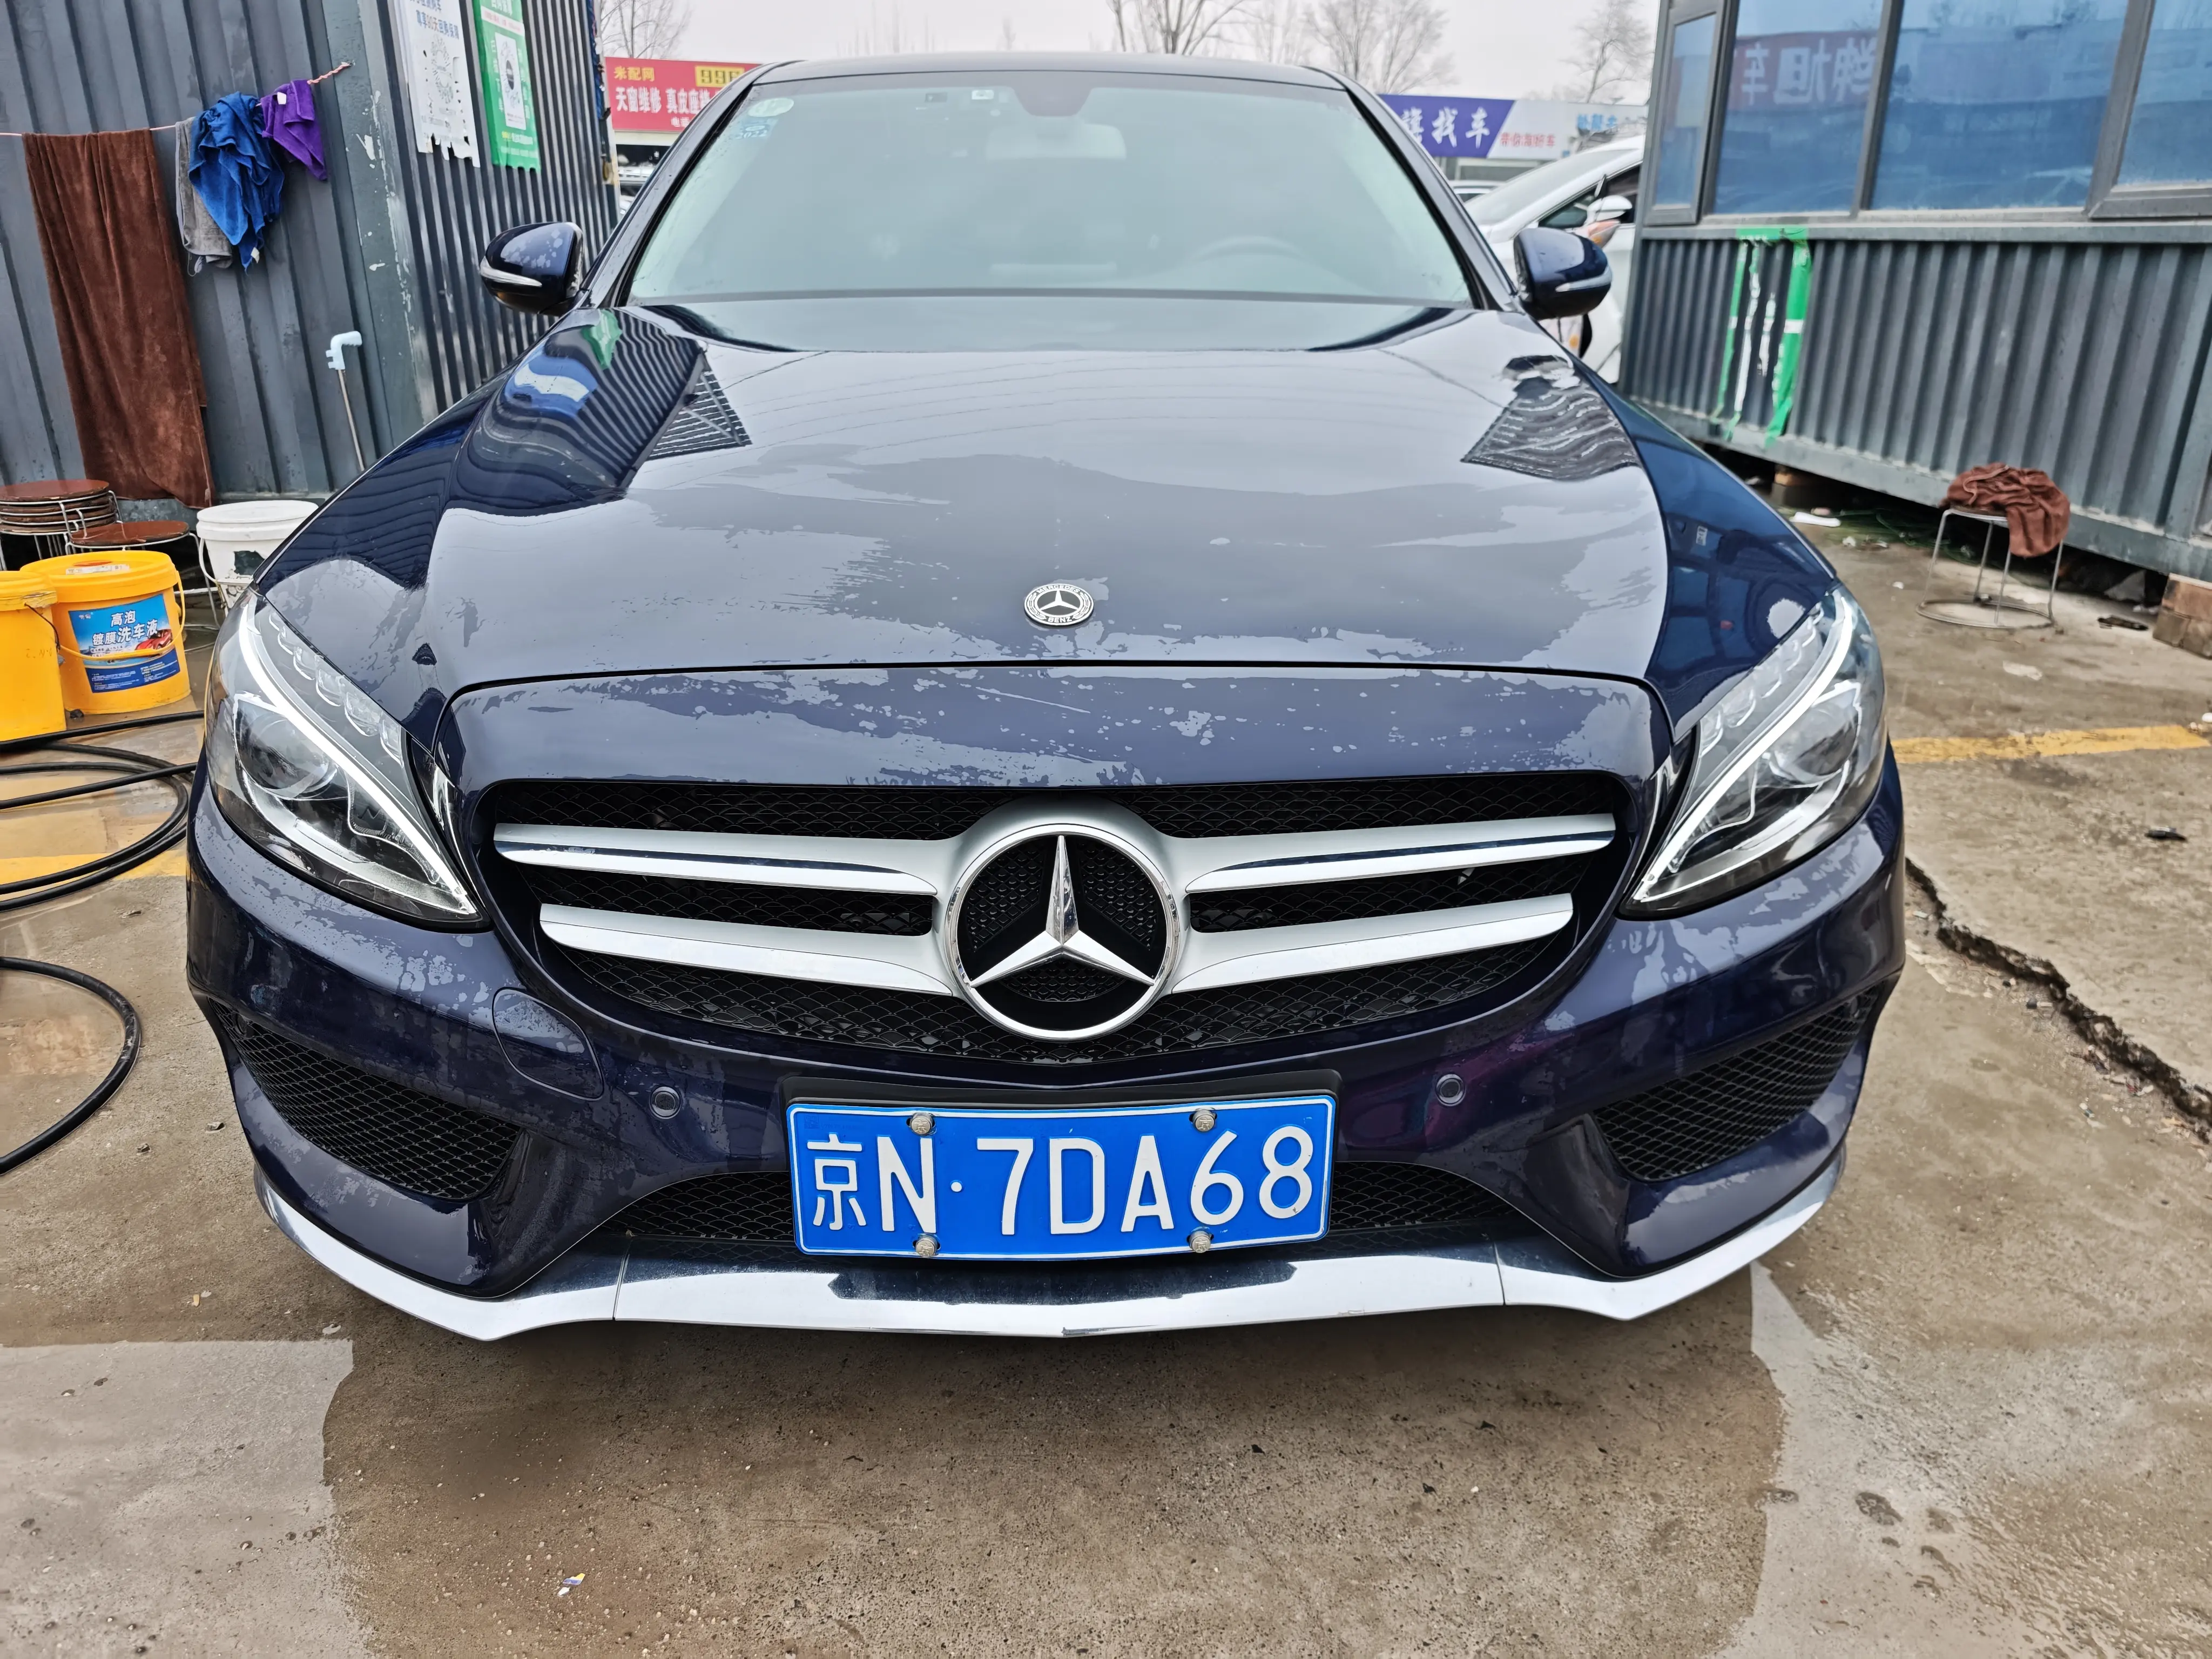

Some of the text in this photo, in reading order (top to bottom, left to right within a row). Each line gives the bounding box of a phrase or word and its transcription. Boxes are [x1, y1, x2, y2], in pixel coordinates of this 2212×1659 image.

[1036, 585, 1080, 594] MERCEDES
[111, 610, 136, 627] 高泡
[92, 619, 158, 646] 镀膜洗车液
[807, 1125, 1314, 1236] 京N·7DA68
